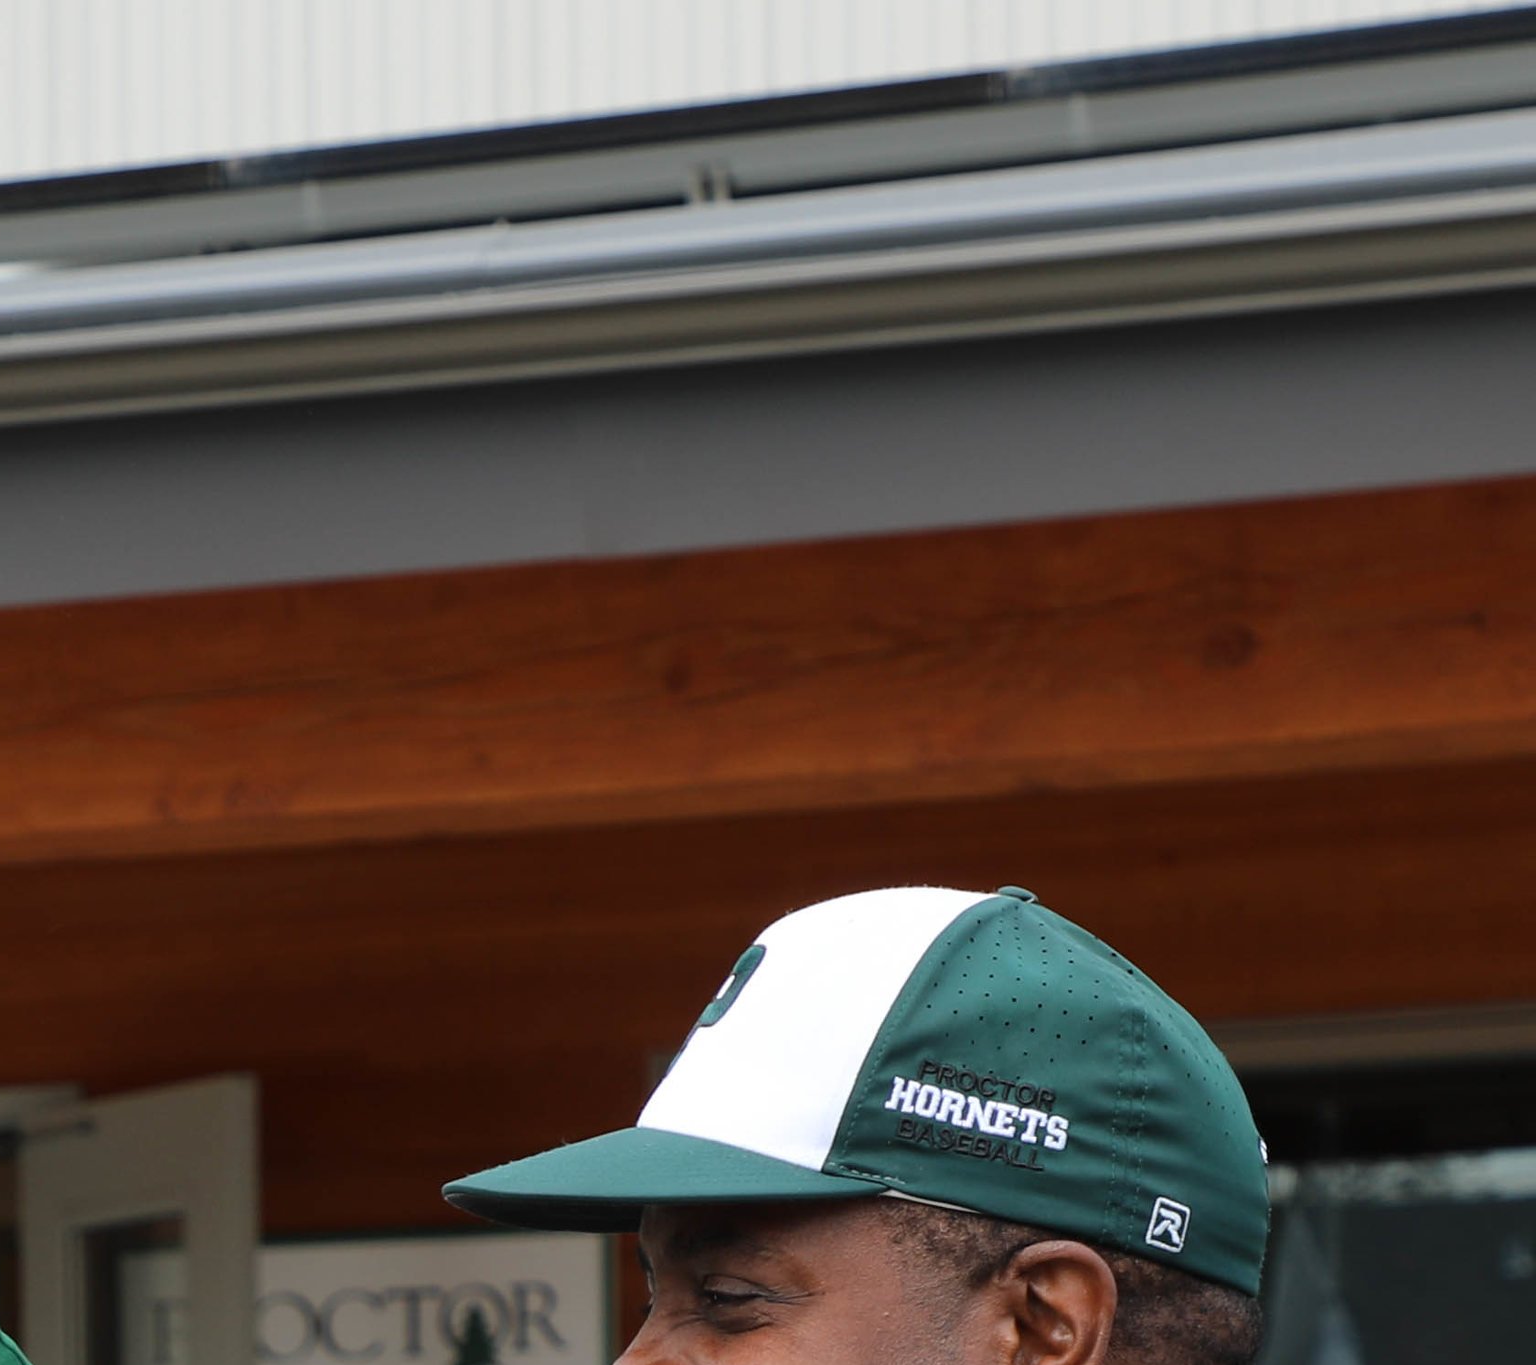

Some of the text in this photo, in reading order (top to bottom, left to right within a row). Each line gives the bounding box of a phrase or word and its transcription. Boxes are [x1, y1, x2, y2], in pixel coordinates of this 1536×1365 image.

[885, 1075, 1070, 1151] HORNETS
[918, 1060, 1057, 1112] PROCTOR
[895, 1117, 1045, 1172] BASEBALL
